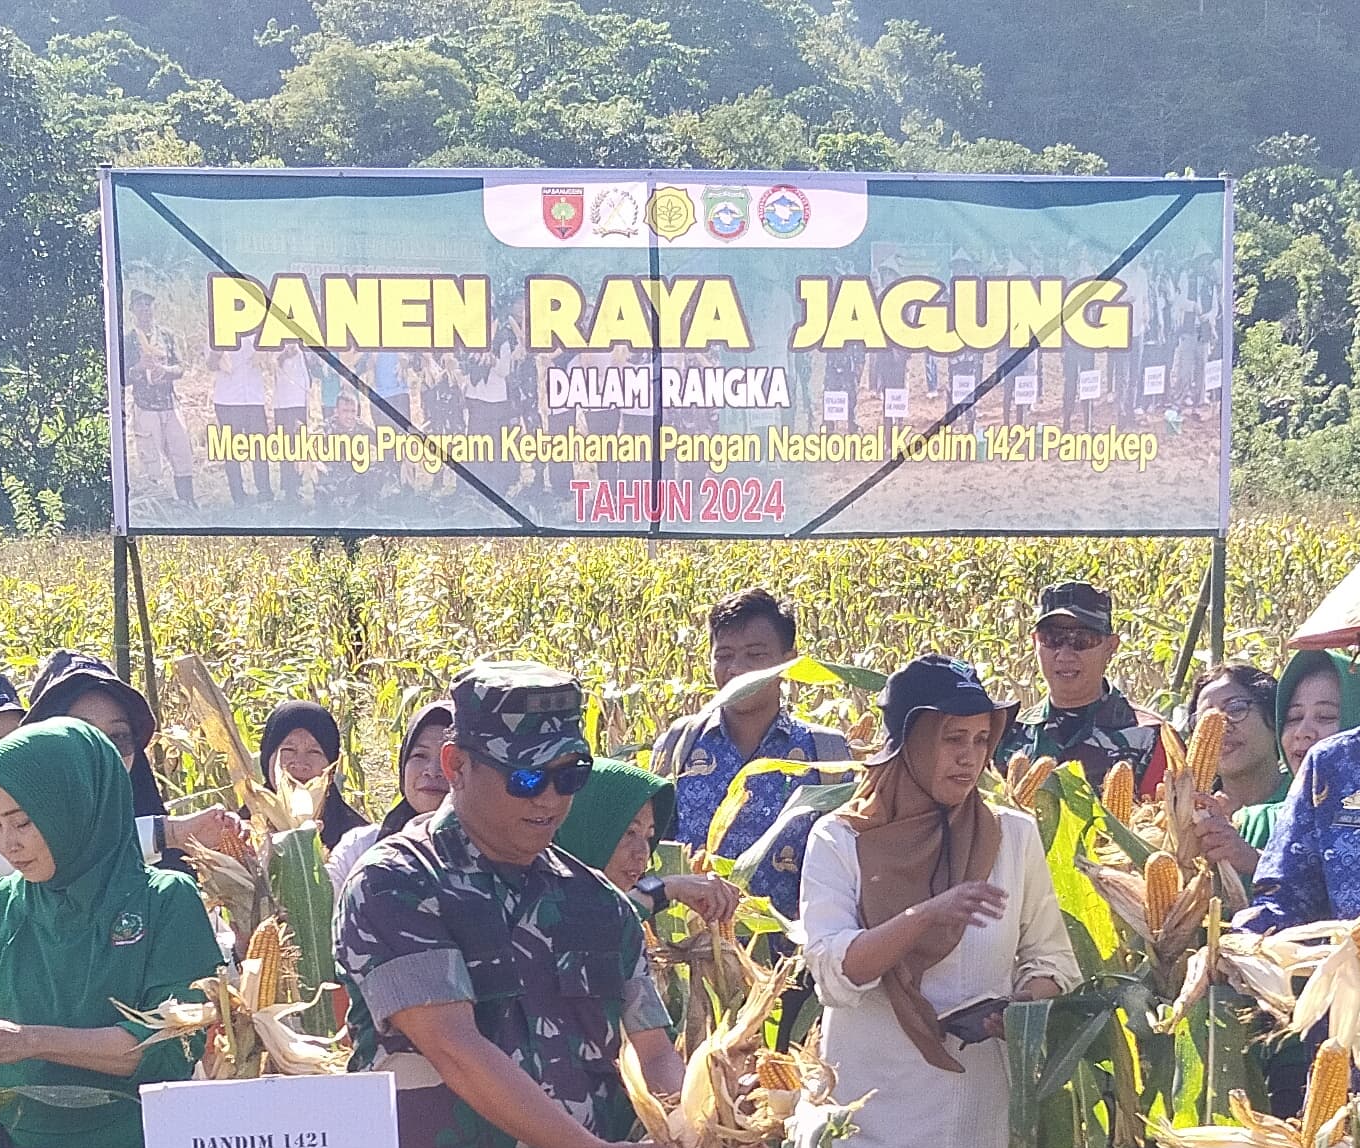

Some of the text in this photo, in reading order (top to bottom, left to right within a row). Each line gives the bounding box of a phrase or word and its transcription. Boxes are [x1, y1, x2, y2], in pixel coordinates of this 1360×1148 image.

[208, 274, 1132, 354] PANEN RAYA JAGUNG
[548, 367, 650, 409] DALAM
[662, 367, 790, 409] RANGKA
[207, 424, 1157, 473] Mendukung Program Ketahanan Pangan Nasional Kodim 1421 Pangkep
[572, 478, 785, 522] TAHUN 2024
[283, 1132, 328, 1148] 1421
